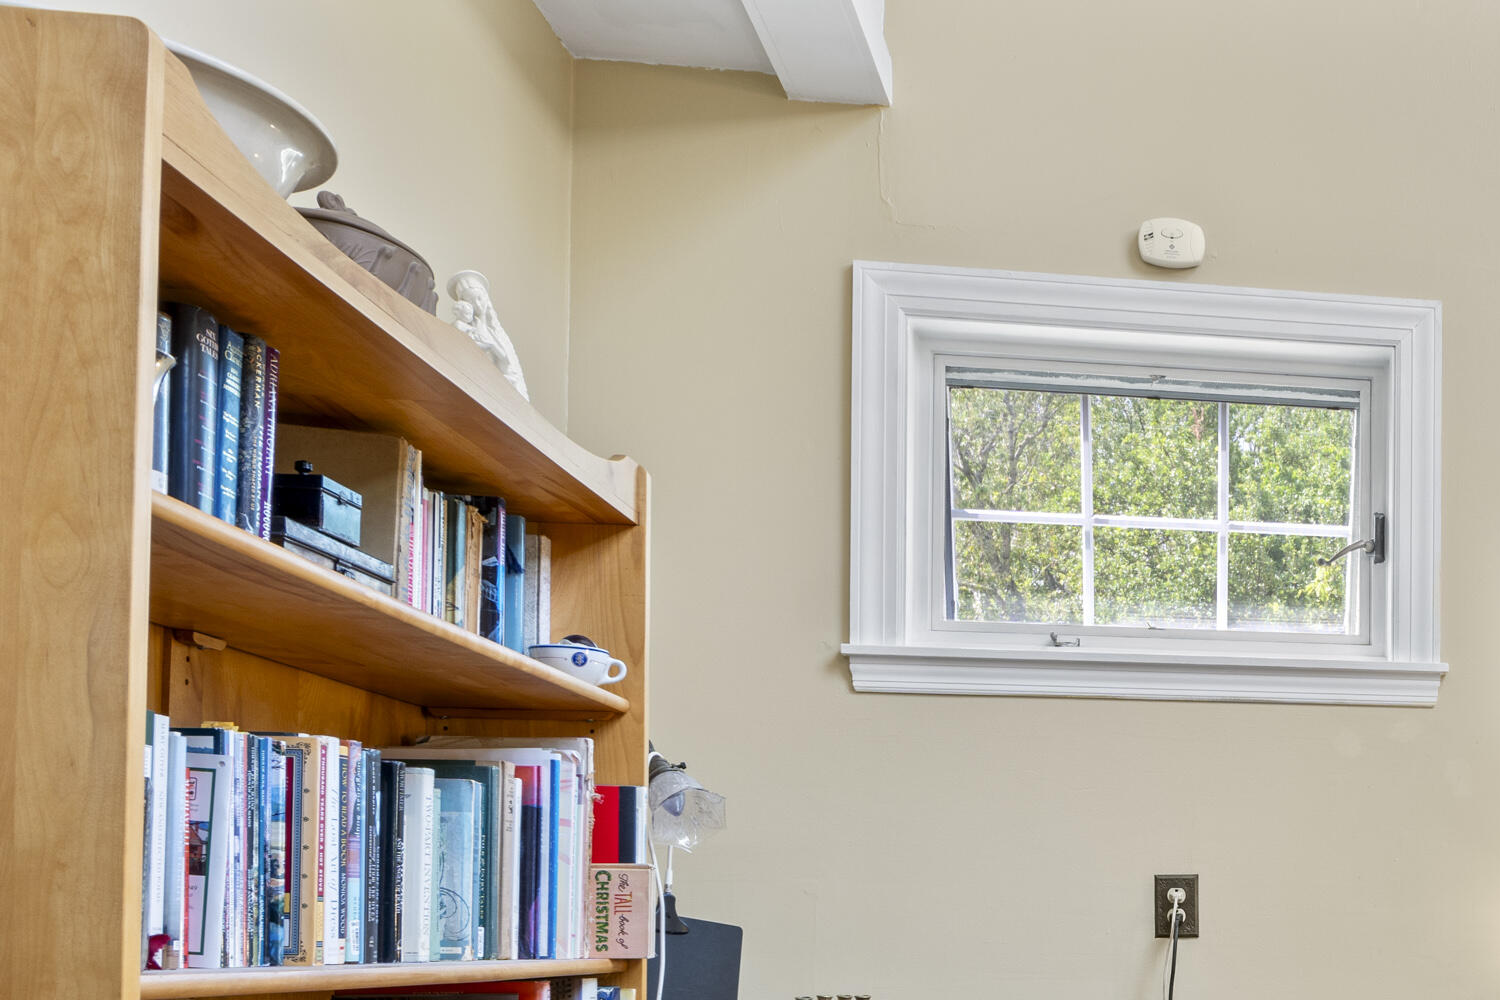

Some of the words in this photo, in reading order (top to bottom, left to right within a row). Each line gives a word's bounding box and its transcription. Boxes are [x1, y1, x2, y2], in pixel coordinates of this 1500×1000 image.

[254, 345, 262, 408] ACKERMAN
[267, 353, 278, 413] ADRIANA
[341, 790, 347, 803] TO
[424, 795, 433, 857] TWO-PART
[422, 863, 432, 936] INVENTION
[595, 870, 611, 953] CHRISTMAS
[613, 891, 633, 915] TALL
[618, 873, 629, 893] The
[618, 914, 630, 937] book
